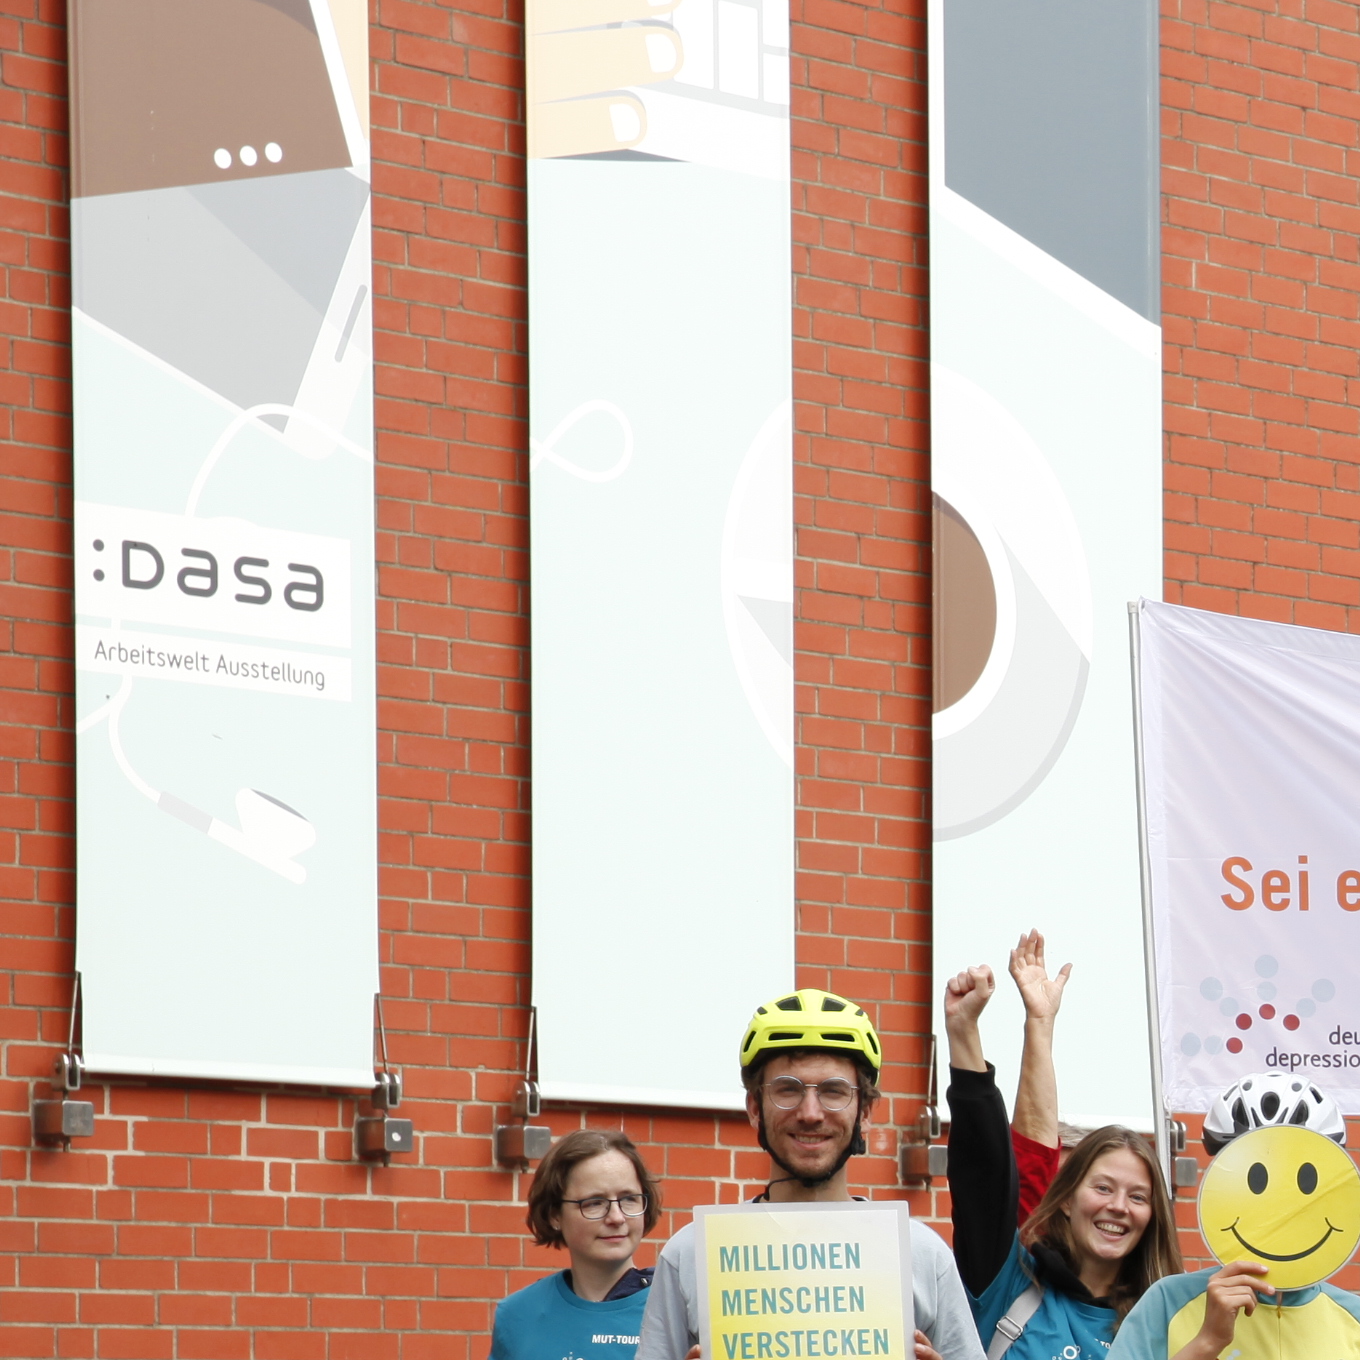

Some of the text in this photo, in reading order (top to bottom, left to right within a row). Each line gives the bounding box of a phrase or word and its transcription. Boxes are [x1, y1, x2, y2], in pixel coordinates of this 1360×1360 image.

[94, 639, 325, 692] Arbeitswelt Ausstellung
[1220, 854, 1311, 913] Sei
[719, 1242, 861, 1272] MILLIONEN
[721, 1285, 865, 1317] MENSCHEN
[722, 1328, 889, 1360] VERSTECKEN
